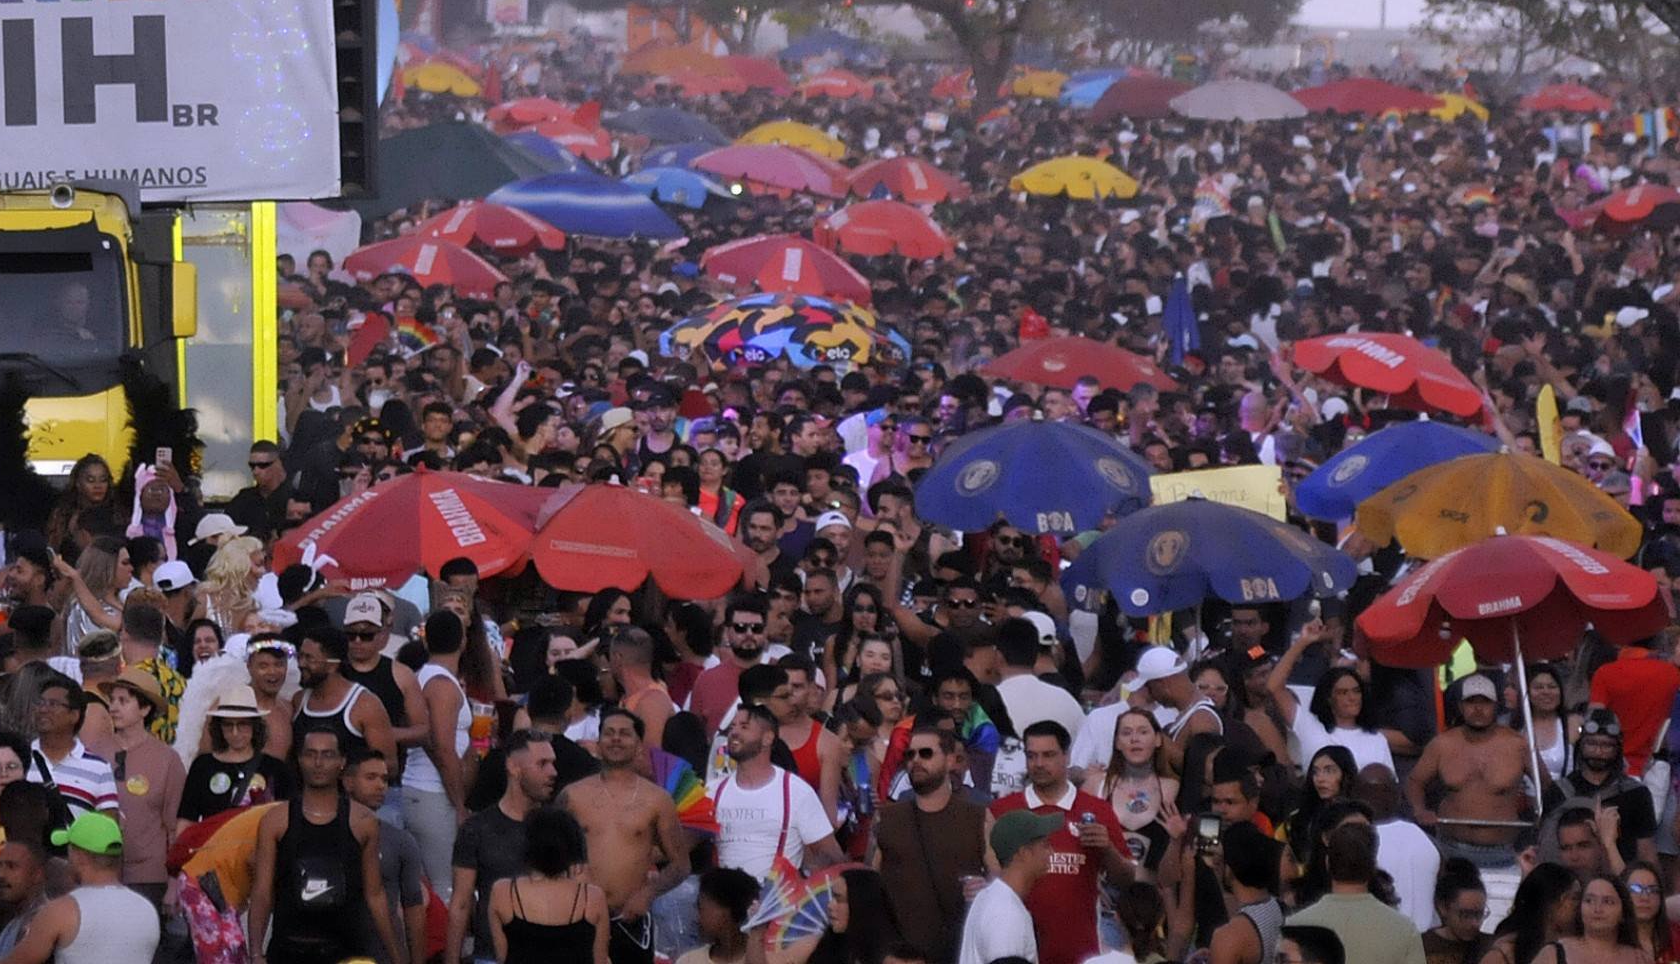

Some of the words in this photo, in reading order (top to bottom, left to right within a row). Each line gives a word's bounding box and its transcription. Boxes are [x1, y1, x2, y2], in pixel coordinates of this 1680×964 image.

[173, 103, 219, 128] BR
[85, 166, 207, 188] HUMANOS
[298, 490, 379, 549] BRAHMA
[428, 488, 486, 548] BRAHMA
[1478, 595, 1523, 616] BRAHMA
